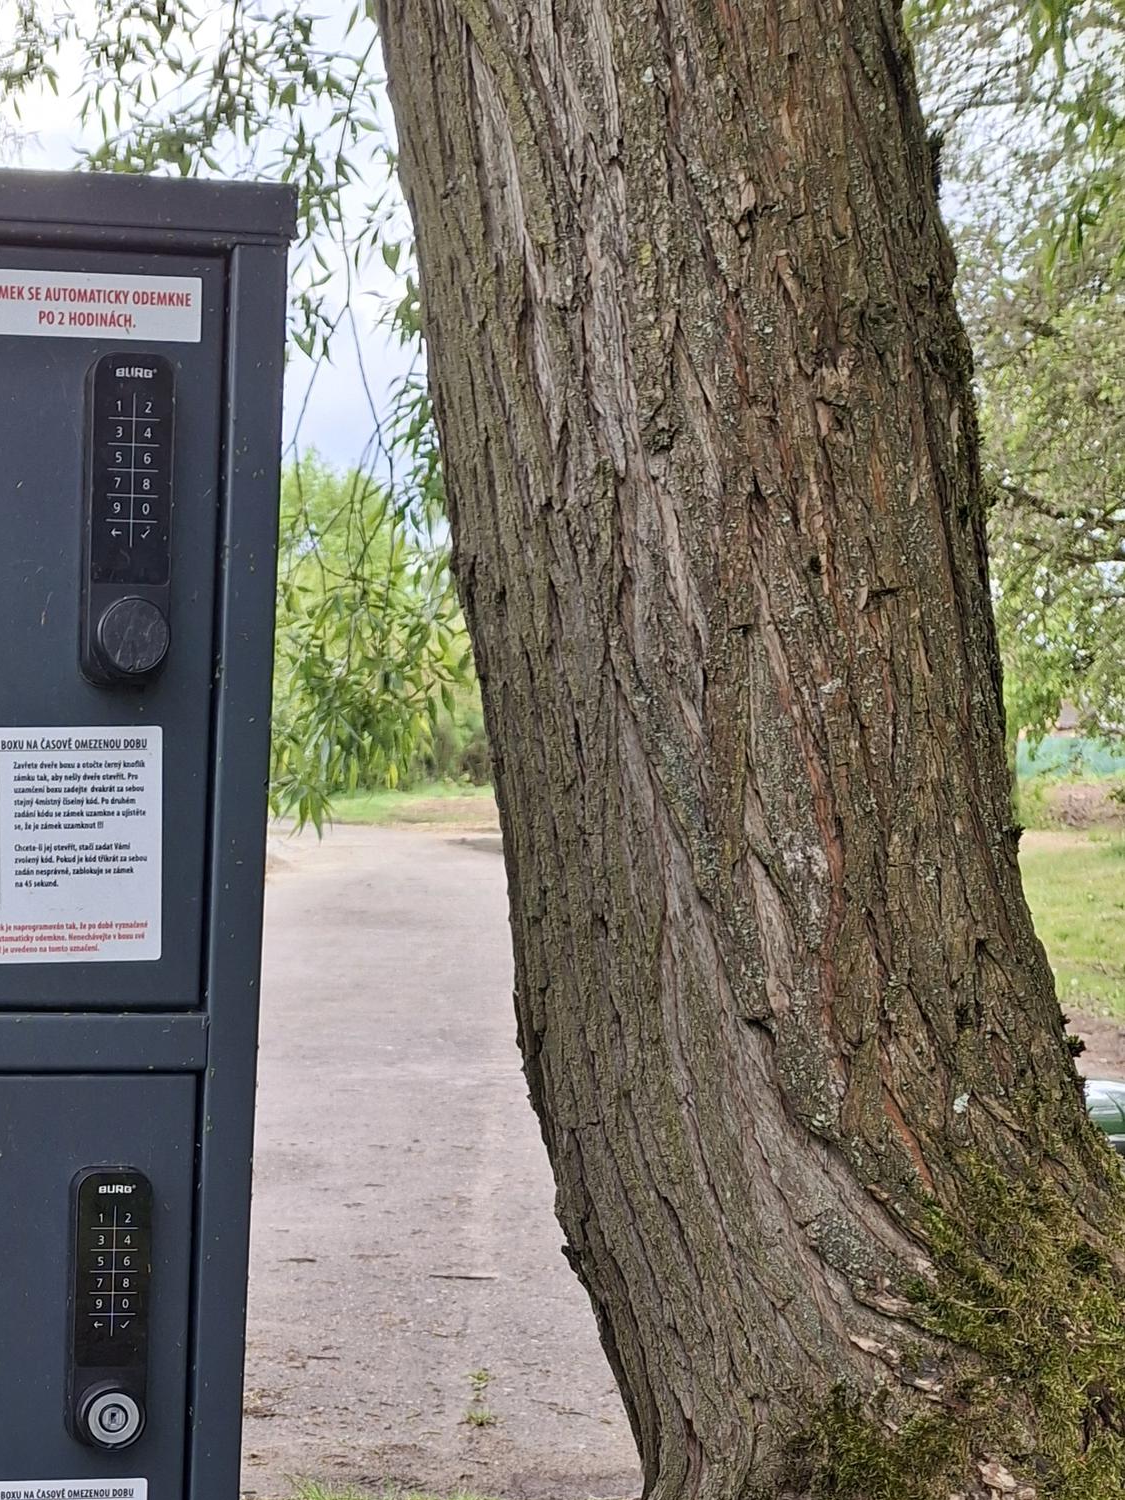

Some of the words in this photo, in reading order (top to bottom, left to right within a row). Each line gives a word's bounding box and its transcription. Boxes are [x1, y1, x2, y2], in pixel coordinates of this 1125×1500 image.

[28, 286, 41, 301] SE
[44, 287, 129, 304] AUTOMATICKY
[132, 291, 191, 307] ODEMKNE
[39, 310, 55, 325] PO
[58, 311, 65, 325] 2
[69, 310, 136, 328] HODINÁCH.
[116, 367, 153, 378] BURG
[117, 400, 121, 412] 1
[145, 402, 152, 413] 2
[116, 426, 123, 438] 3
[144, 427, 151, 438] 4
[115, 451, 122, 463] 5
[144, 453, 151, 464] 6
[114, 477, 121, 488] 7
[143, 478, 150, 490] 8
[113, 502, 121, 514] 9
[142, 503, 150, 515] 0
[0, 739, 24, 750] BOXU
[26, 739, 39, 750] NA
[40, 737, 73, 750] ČASOVĚ
[74, 738, 122, 749] OMEZENOU
[123, 738, 148, 749] DOBU
[98, 1185, 132, 1193] BURG
[0, 1490, 22, 1500] BOXU
[23, 1490, 35, 1499] NA
[36, 1488, 66, 1499] ČASOVĚ
[67, 1489, 111, 1498] OMEZENOU
[112, 1488, 134, 1497] DOBU
